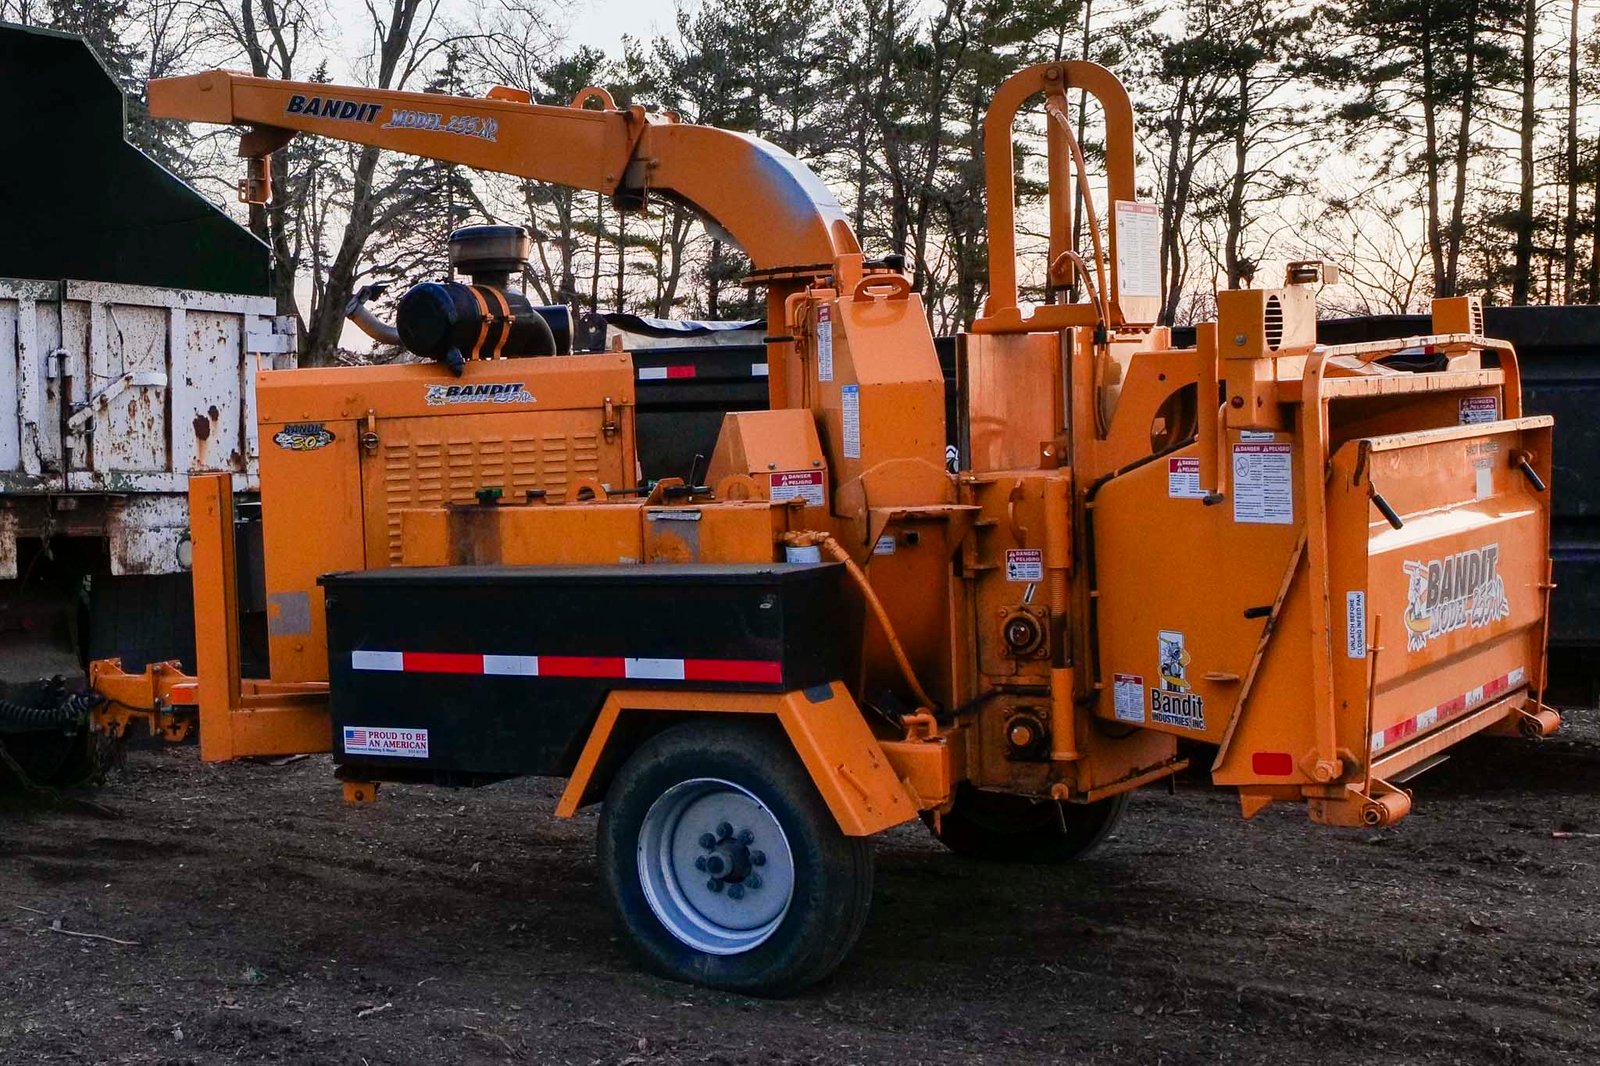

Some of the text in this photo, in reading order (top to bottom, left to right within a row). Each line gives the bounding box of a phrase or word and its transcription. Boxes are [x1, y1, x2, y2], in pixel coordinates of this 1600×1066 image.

[286, 95, 383, 122] BANDIT
[391, 109, 442, 130] MODEL
[446, 383, 524, 397] BANDIT
[1426, 546, 1498, 609] BANDIT
[1151, 688, 1203, 719] Bandit
[368, 731, 397, 740] PROUD
[415, 733, 427, 741] BE
[383, 741, 426, 749] AMERICAN
